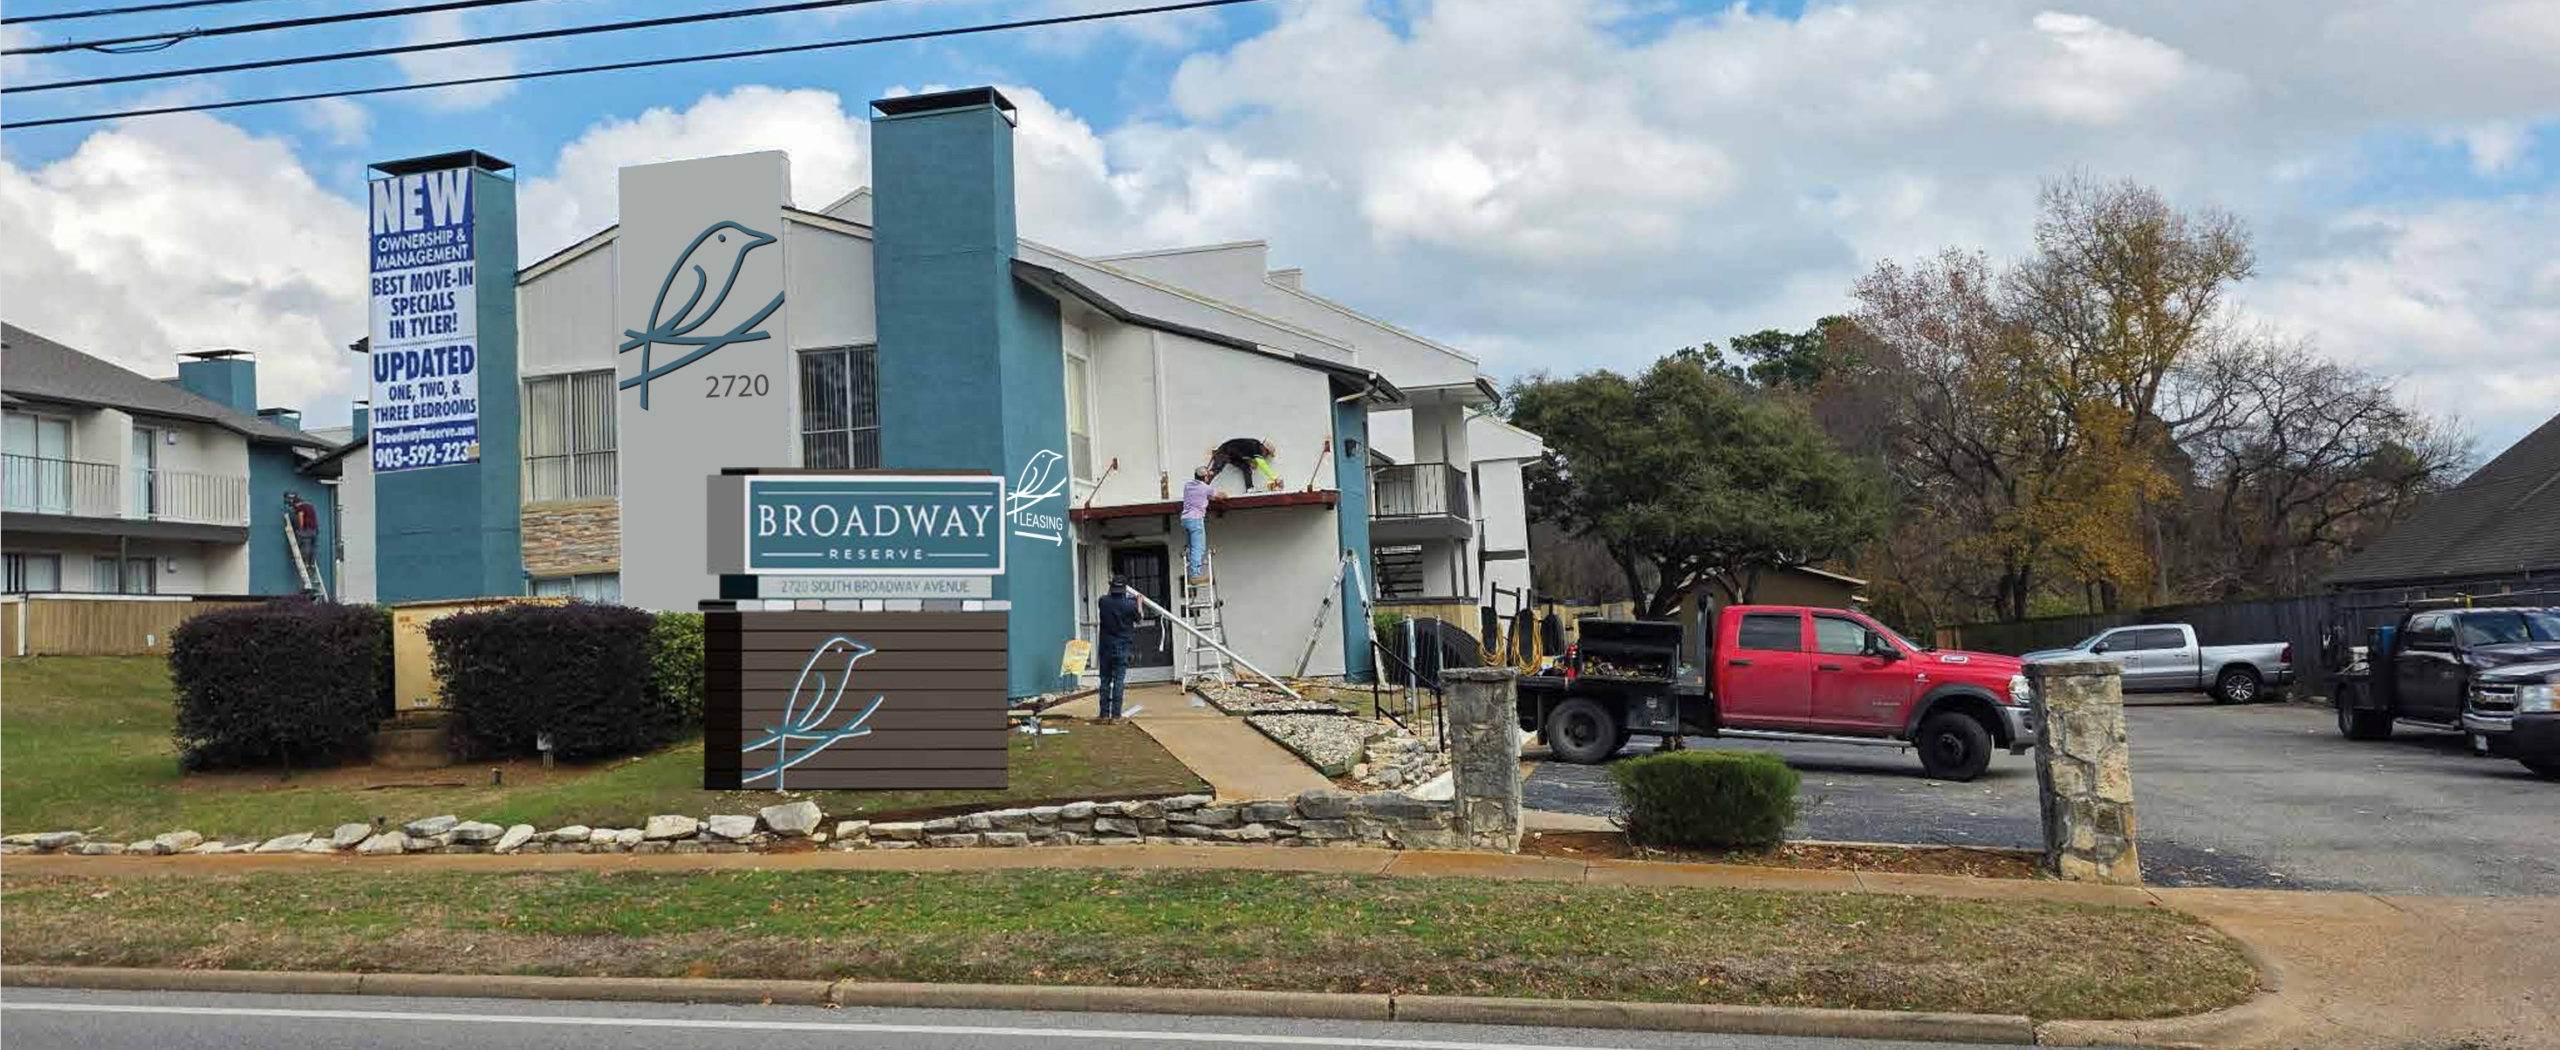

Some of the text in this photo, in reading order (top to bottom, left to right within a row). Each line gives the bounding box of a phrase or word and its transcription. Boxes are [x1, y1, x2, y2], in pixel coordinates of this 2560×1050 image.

[373, 168, 469, 235] NEW
[378, 227, 466, 252] OWNERSHIP &
[376, 243, 469, 270] MANAGEMENT
[372, 266, 474, 297] BEST MOVE-IN
[391, 291, 455, 316] SPECIALS
[389, 312, 457, 339] IN TYLER!
[373, 345, 475, 383] UPDATED
[389, 379, 461, 403] ONE, TWO, &
[705, 373, 770, 399] 2720
[374, 398, 477, 423] THREE BEDROOMS
[375, 440, 477, 469] 903-592-223
[758, 504, 994, 537] BROADWAY
[1020, 511, 1063, 531] LEASING
[829, 549, 923, 560] RESERVE
[781, 580, 970, 593] 2720 SOUTH BROADWAY AVENUE
